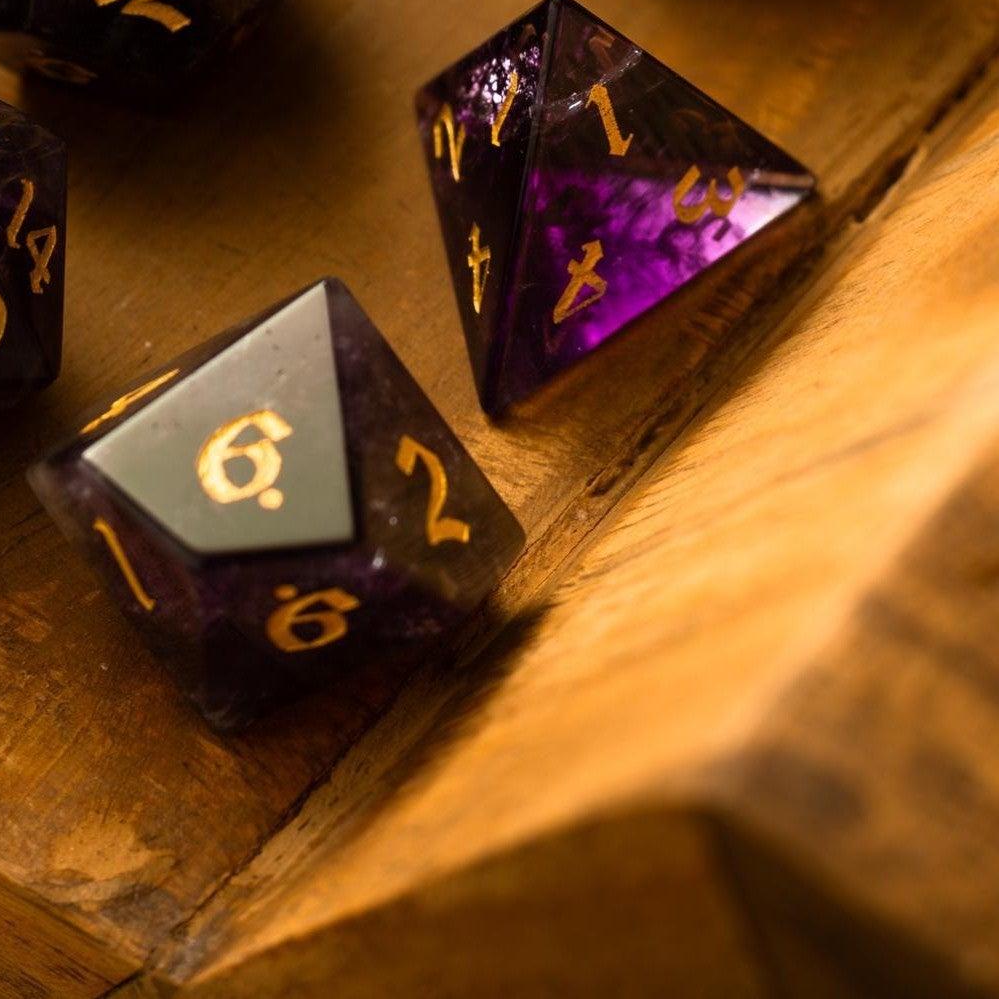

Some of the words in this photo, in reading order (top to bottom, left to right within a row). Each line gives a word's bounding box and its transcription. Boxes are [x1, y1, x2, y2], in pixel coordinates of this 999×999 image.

[433, 103, 466, 181] 2
[492, 70, 519, 147] 1
[585, 83, 633, 157] 1
[673, 165, 745, 225] 3
[6, 178, 57, 294] 14
[468, 221, 492, 314] 4
[553, 239, 608, 324] 4
[395, 435, 470, 546] 2
